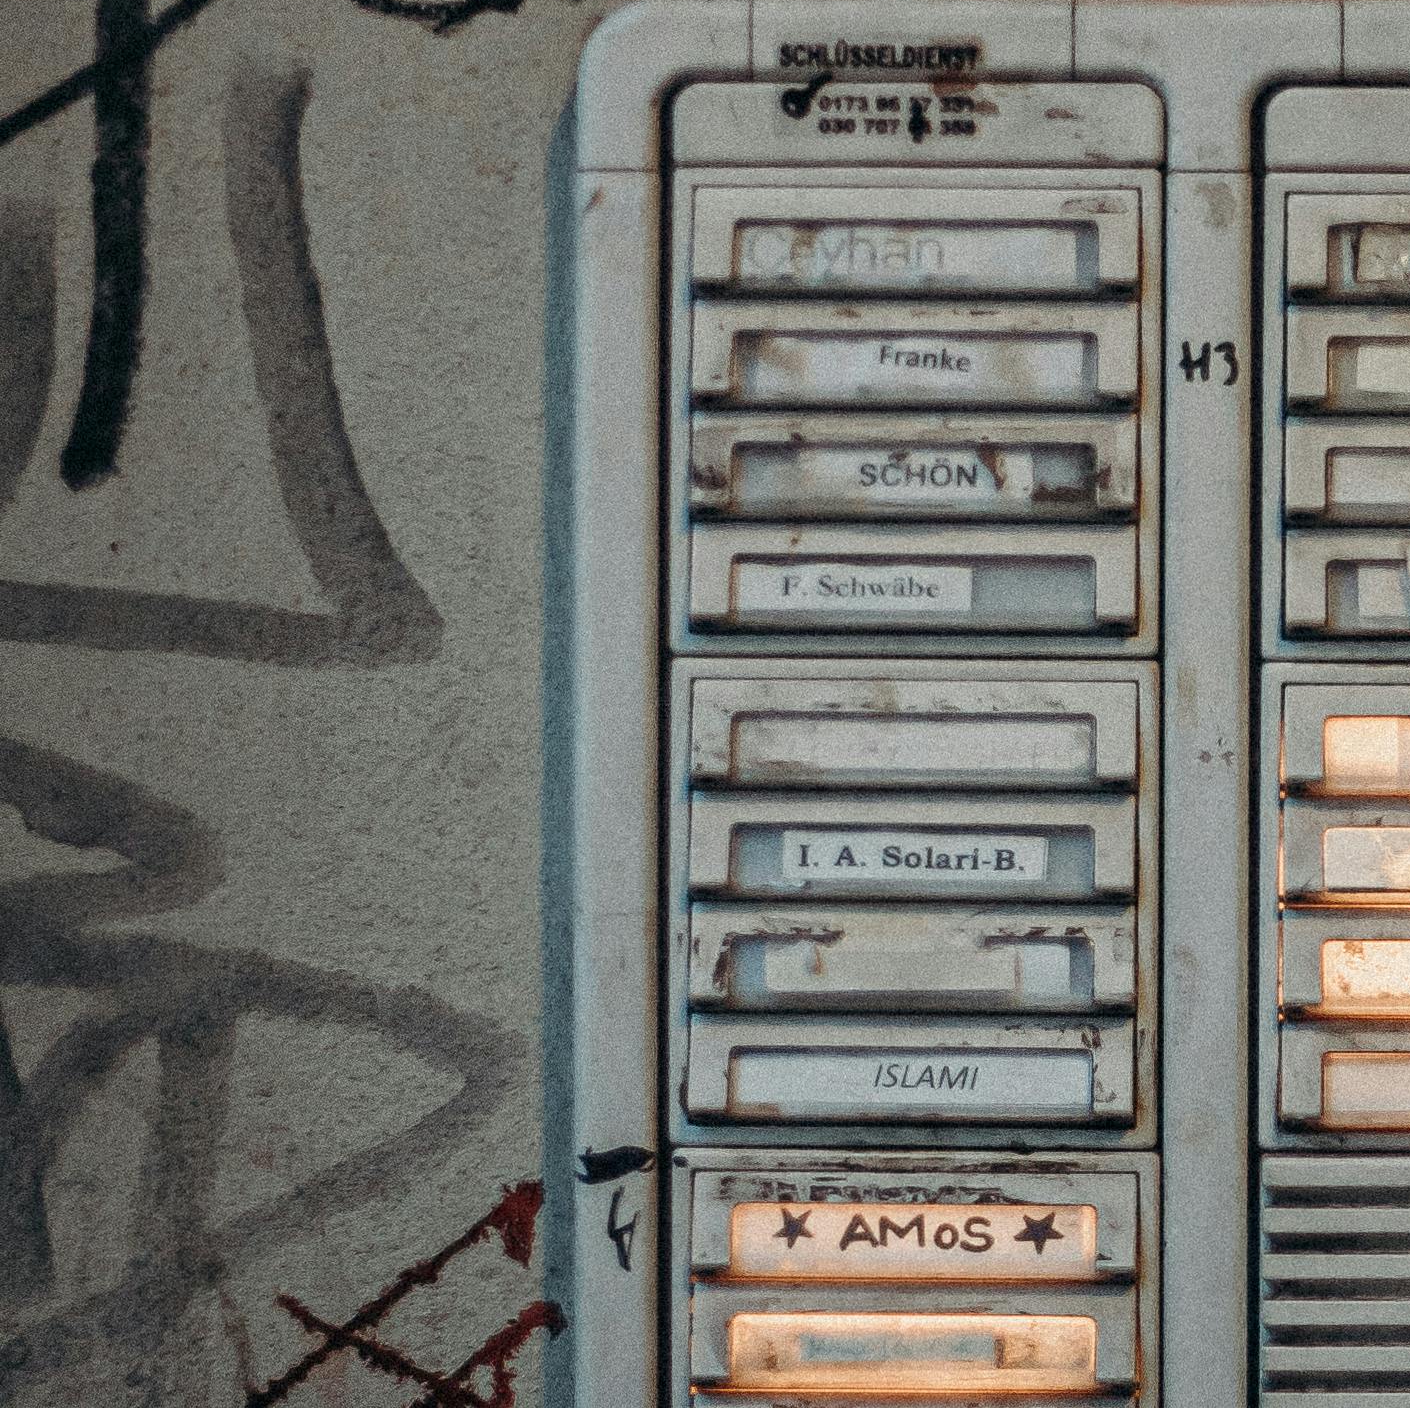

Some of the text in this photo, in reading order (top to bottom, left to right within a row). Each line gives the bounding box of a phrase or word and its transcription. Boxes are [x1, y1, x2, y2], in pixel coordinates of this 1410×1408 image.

[779, 39, 978, 70] SCHLÜSSELDIENST
[879, 344, 972, 374] Franke
[860, 457, 978, 488] SCHÖN
[833, 845, 867, 868] A.
[881, 845, 1026, 872] Solari-B.
[873, 1063, 981, 1091] ISLAMI
